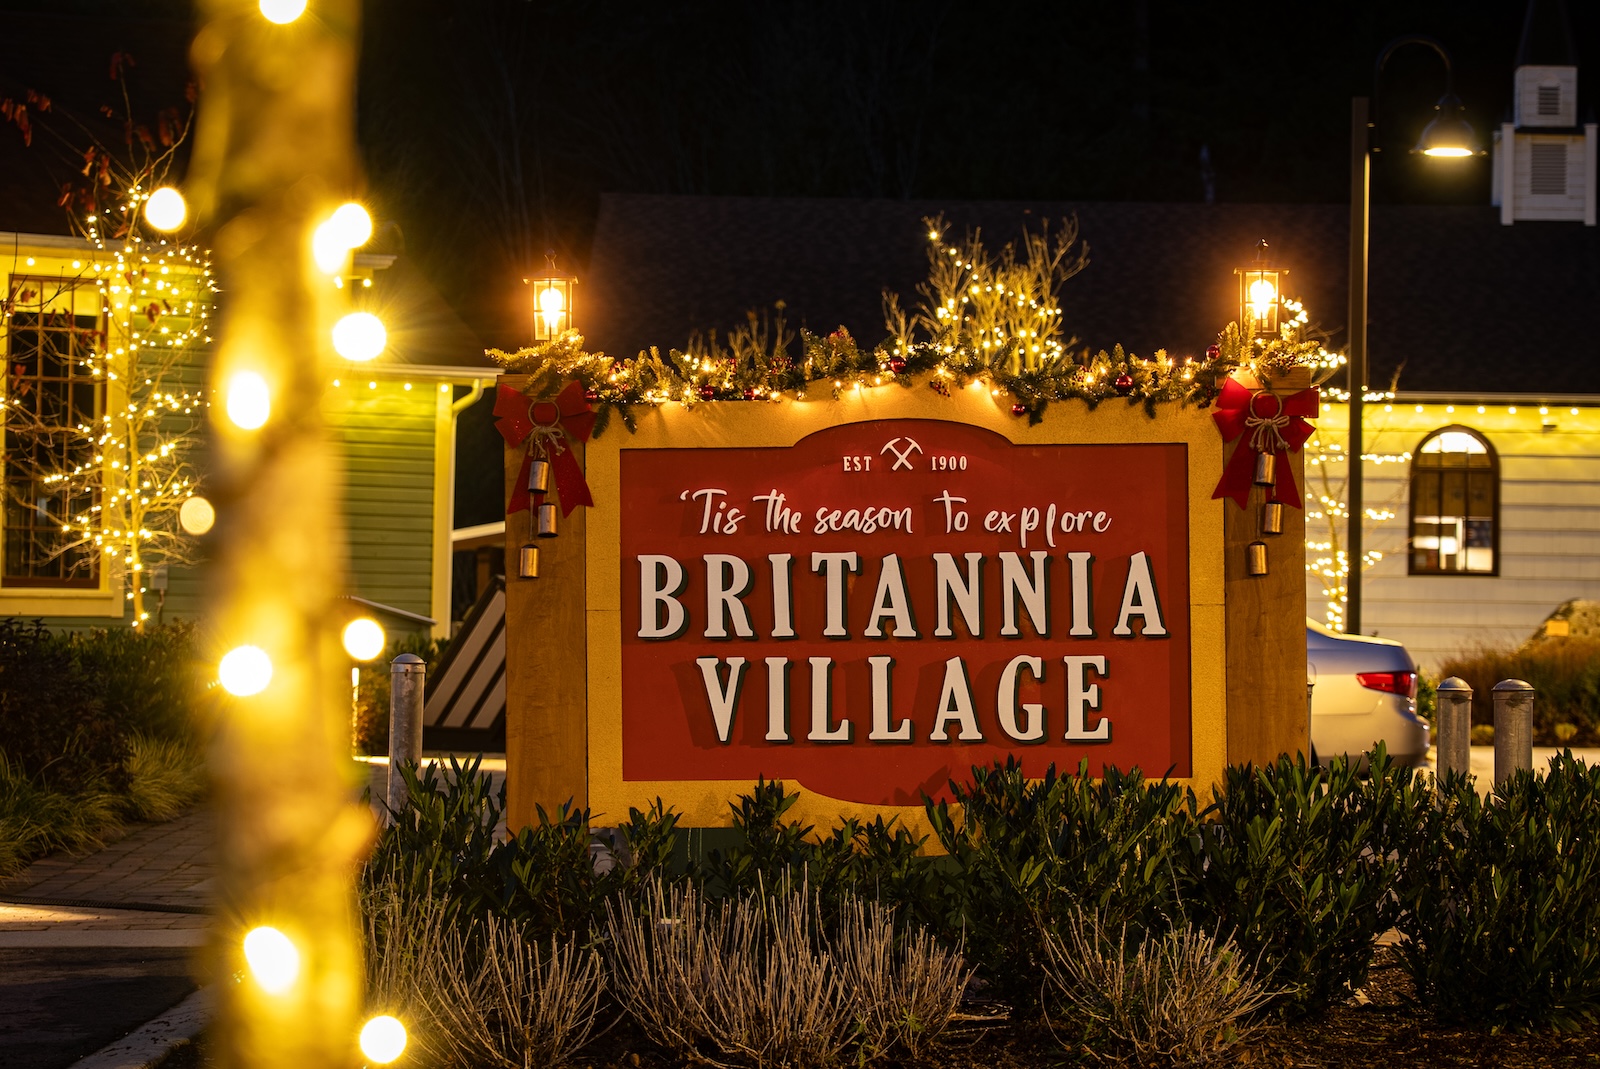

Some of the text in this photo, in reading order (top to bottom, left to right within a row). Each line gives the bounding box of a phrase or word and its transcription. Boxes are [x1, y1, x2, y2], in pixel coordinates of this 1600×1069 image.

[843, 455, 967, 472] EST 1900
[752, 488, 802, 535] the
[813, 506, 913, 535] season
[932, 489, 969, 534] to
[984, 503, 1112, 549] explore
[637, 550, 1166, 640] BRITANNIA
[696, 654, 1110, 743] VILLAGE
